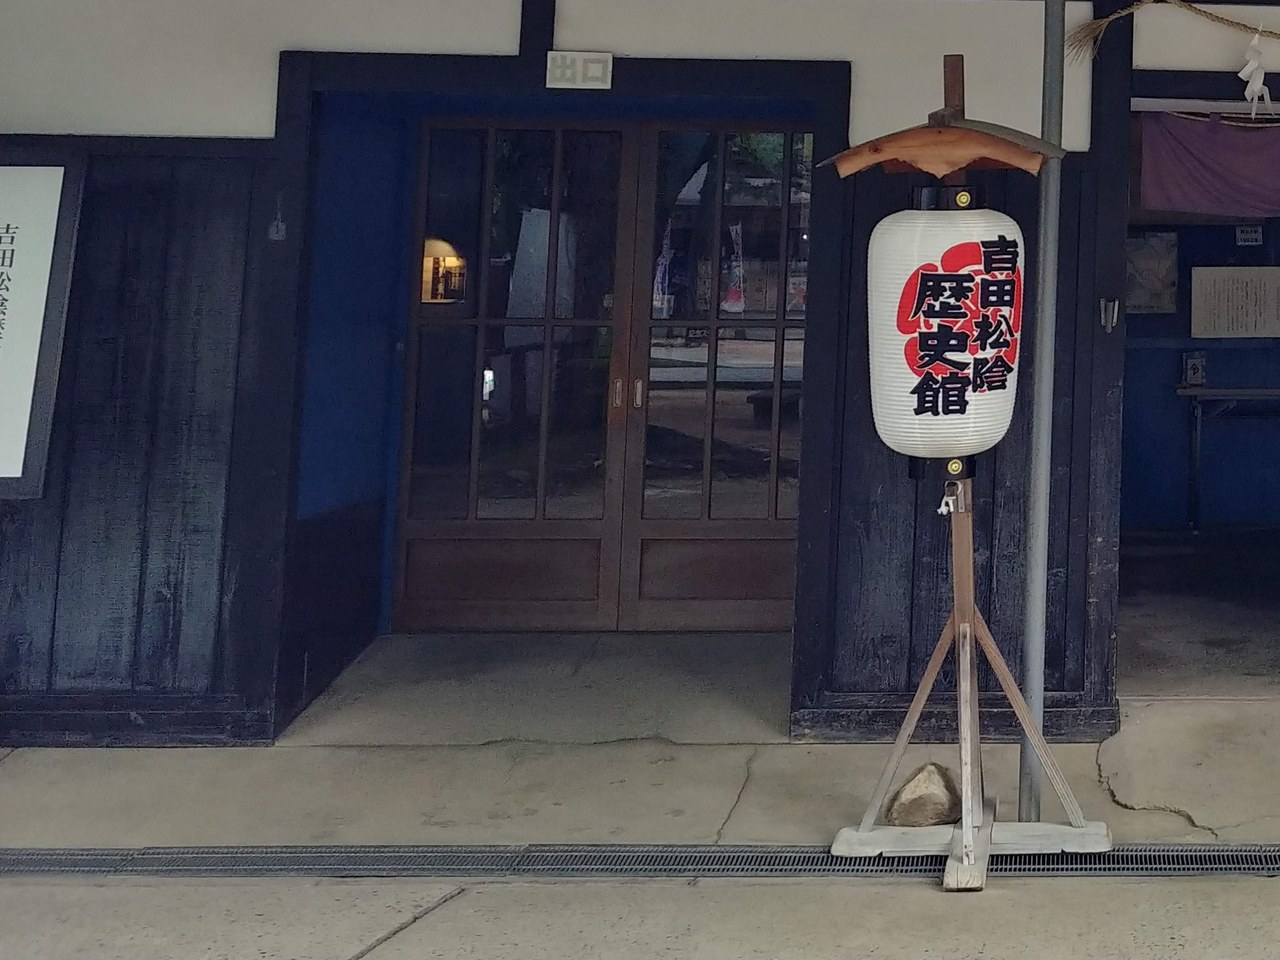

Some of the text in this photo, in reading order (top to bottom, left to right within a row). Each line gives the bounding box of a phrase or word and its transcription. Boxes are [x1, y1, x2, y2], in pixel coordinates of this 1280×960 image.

[549, 54, 609, 84] 出口
[909, 271, 977, 417] 歴史館
[971, 234, 1020, 394] 吉田松陰
